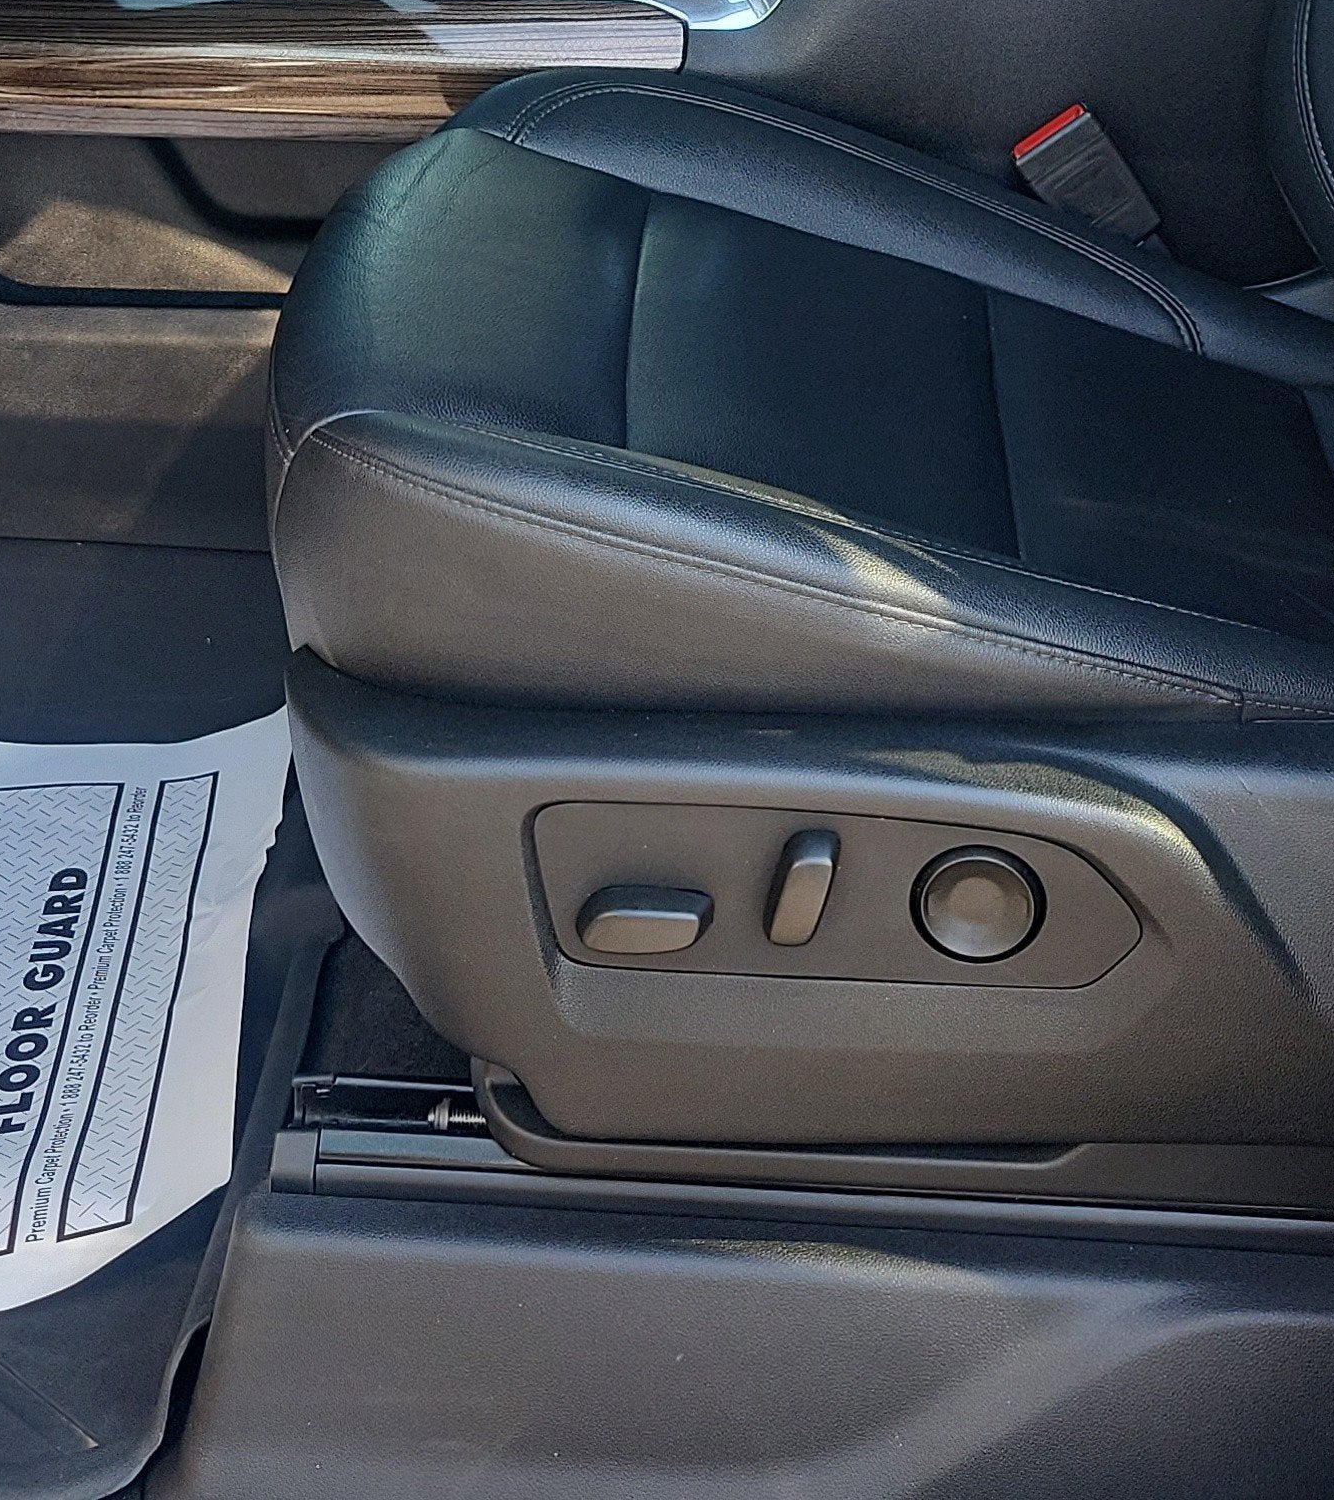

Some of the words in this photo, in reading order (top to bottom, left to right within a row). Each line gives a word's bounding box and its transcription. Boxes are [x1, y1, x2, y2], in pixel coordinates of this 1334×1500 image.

[126, 787, 147, 813] Reorder
[127, 814, 141, 822] to
[117, 824, 139, 858] 247-5432
[114, 861, 133, 874] 888
[103, 888, 127, 927] Protection
[23, 867, 88, 991] GUARD
[96, 929, 120, 954] Carpet
[87, 955, 112, 990] Premium
[78, 997, 101, 1031] Reorder
[79, 1033, 94, 1042] to
[66, 1044, 92, 1081] 247-5432
[61, 1084, 82, 1099] 888
[44, 1113, 74, 1153] Protection
[35, 1154, 62, 1185] Carpet
[25, 1187, 52, 1242] Premium
